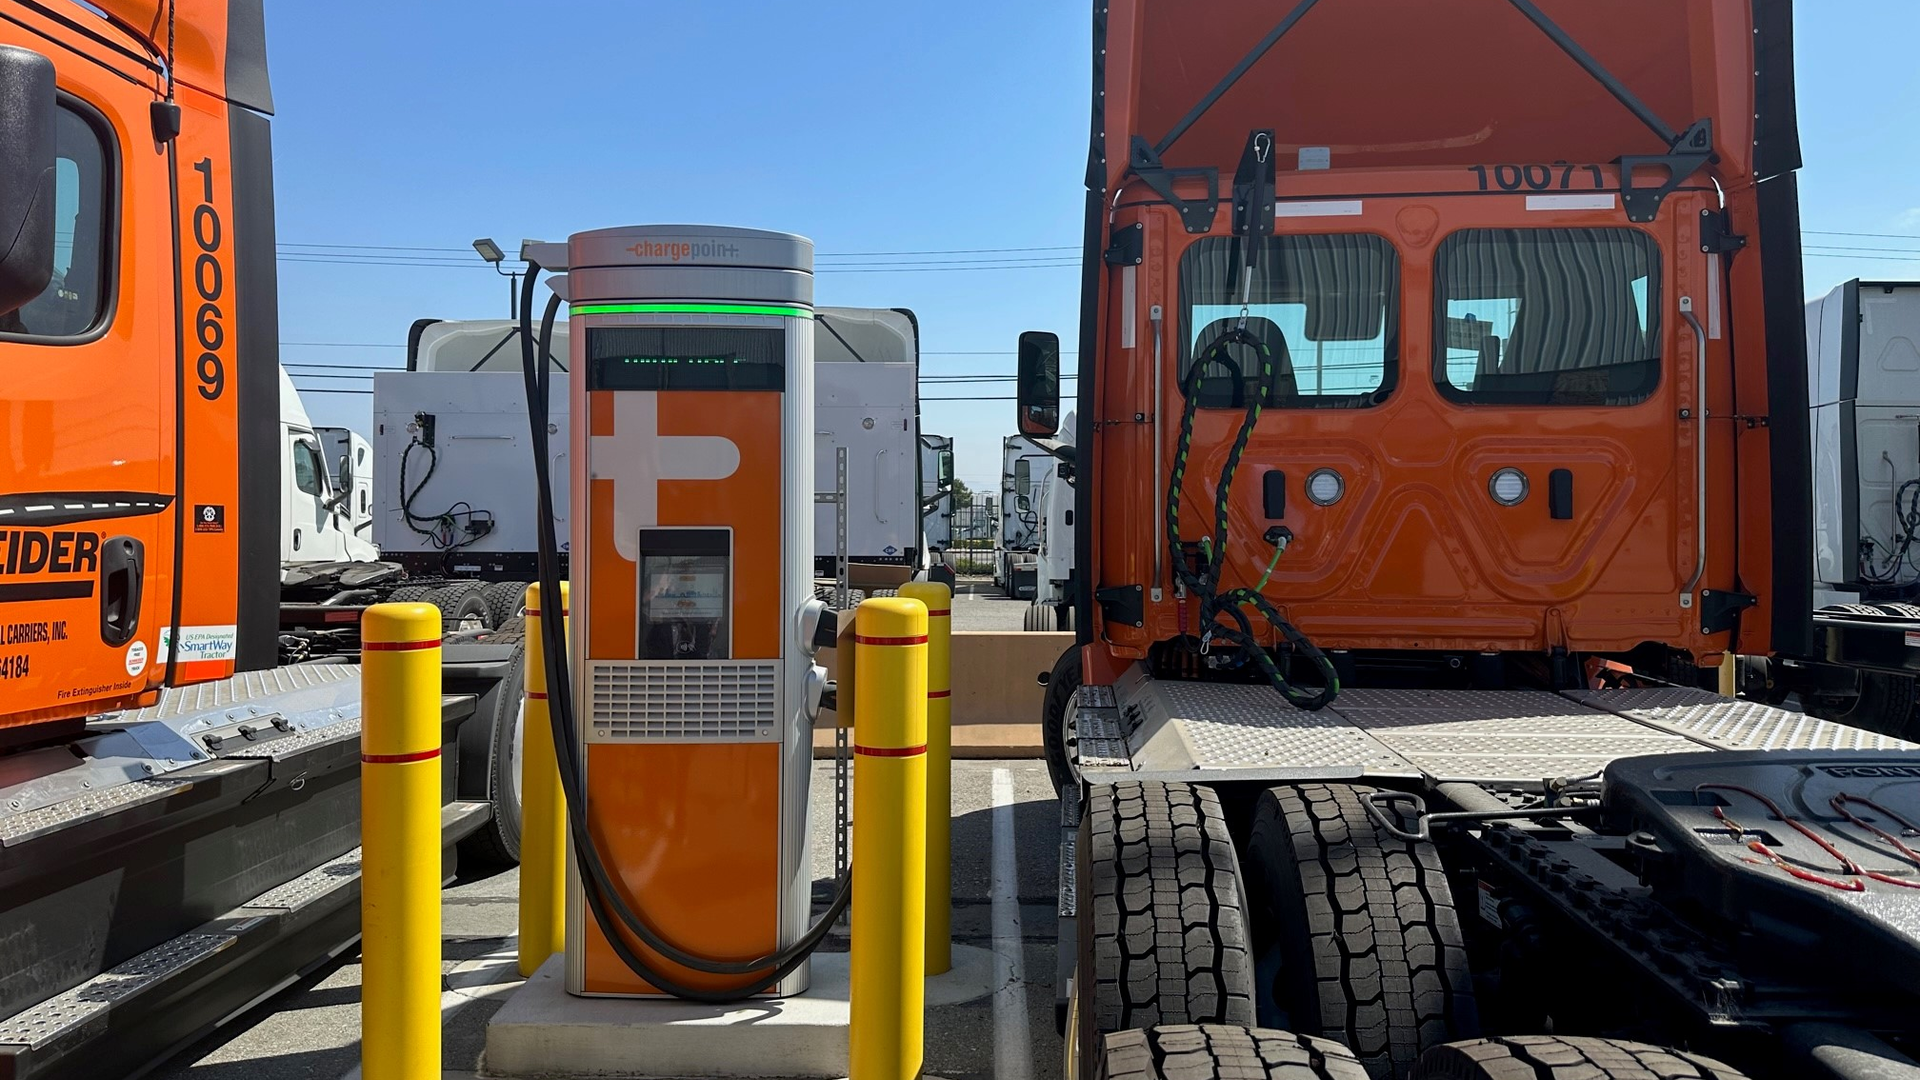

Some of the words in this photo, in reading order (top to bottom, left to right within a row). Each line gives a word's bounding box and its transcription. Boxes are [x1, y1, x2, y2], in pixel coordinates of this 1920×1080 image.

[1468, 164, 1604, 190] 10071
[193, 157, 225, 401] 10069
[7, 622, 50, 645] CARRIERS,
[52, 620, 68, 640] INC.
[185, 640, 232, 652] SmartWay
[201, 651, 226, 659] Tractor
[0, 654, 29, 679] 4184
[57, 690, 71, 699] Fire
[72, 684, 113, 697] Extinguisher
[113, 680, 132, 691] Inside
